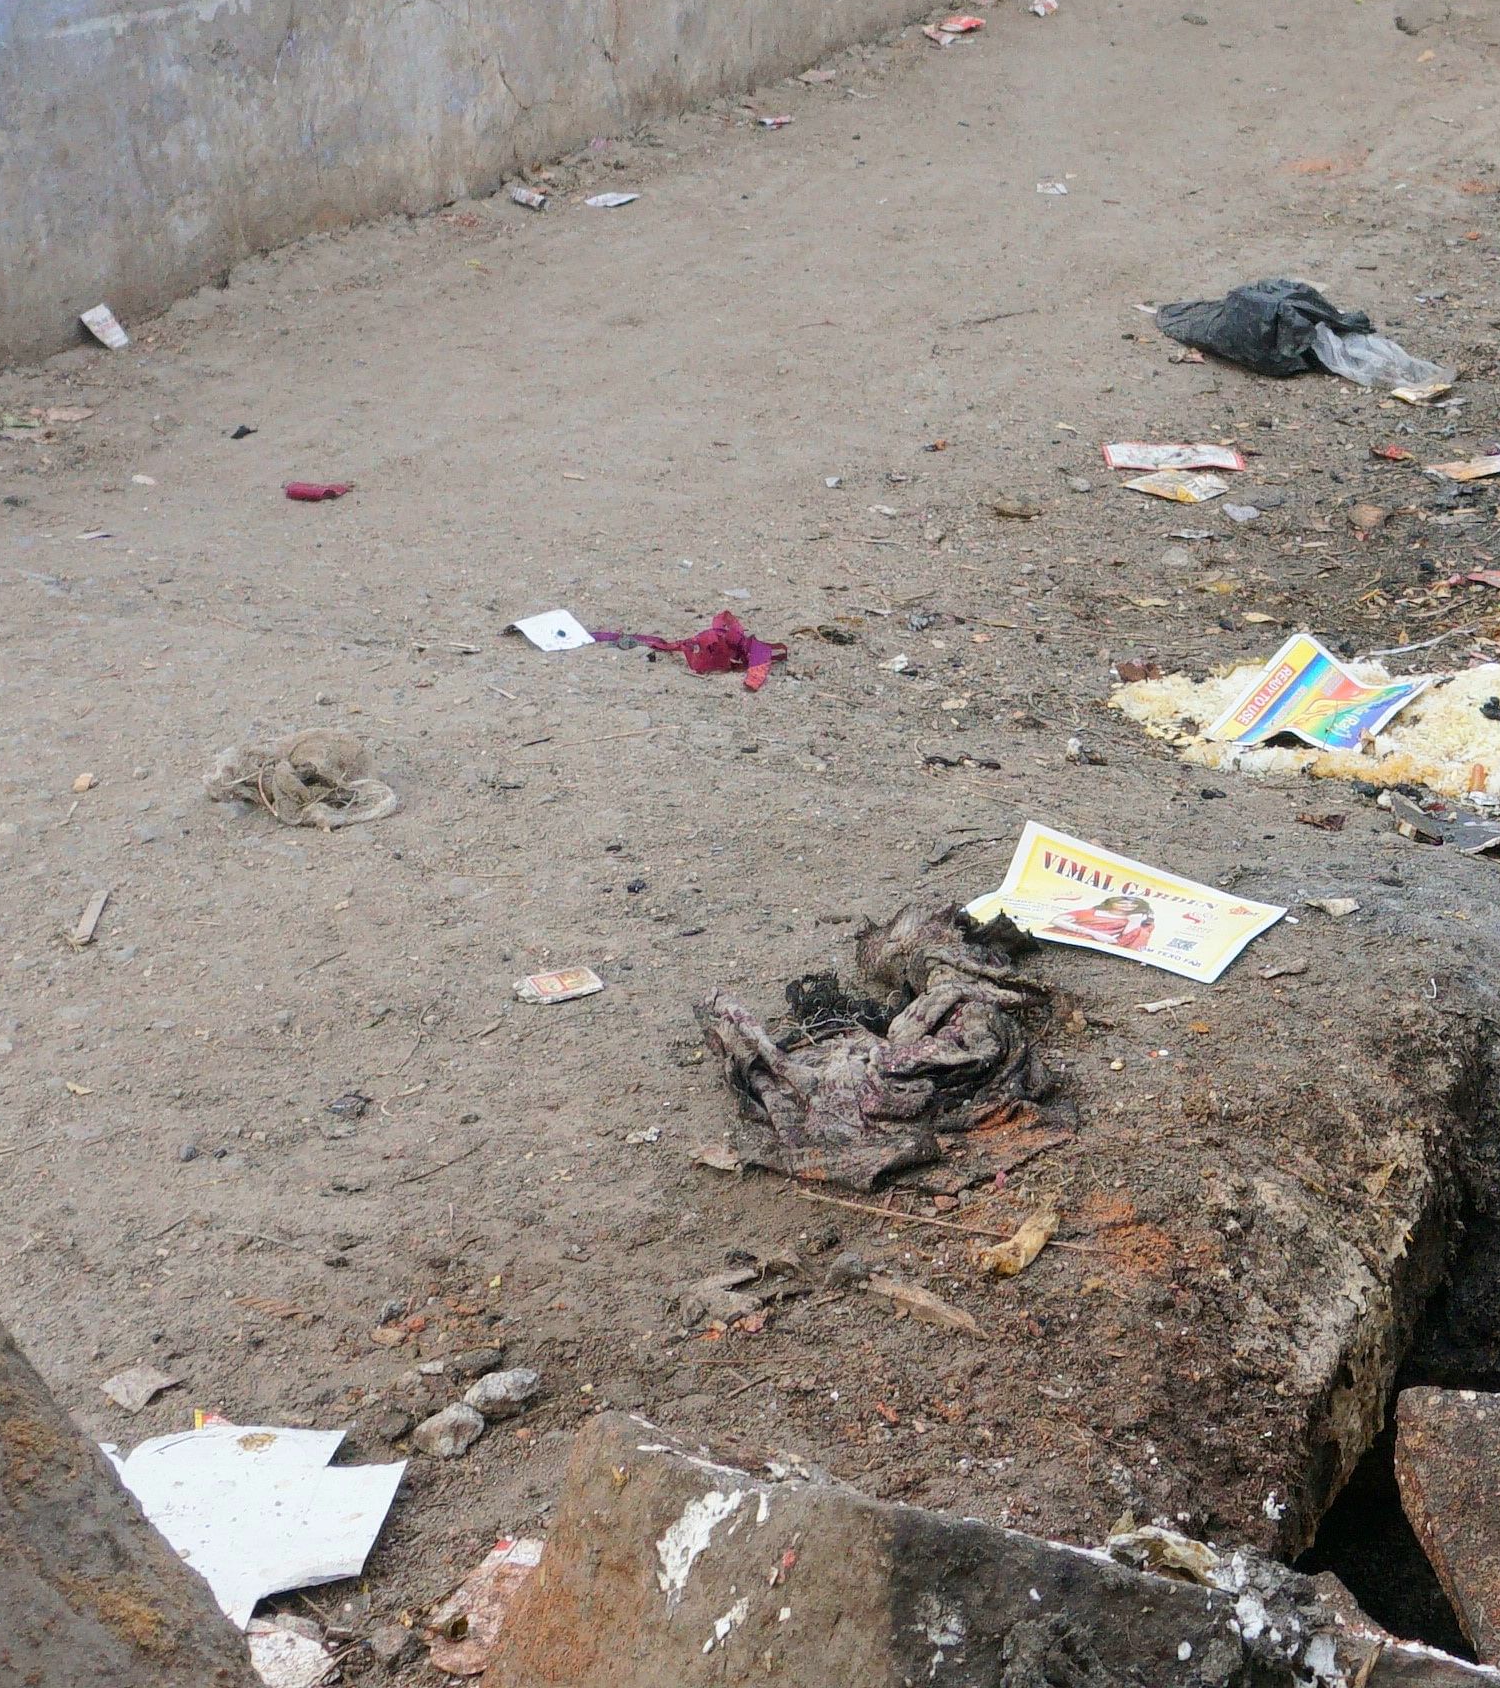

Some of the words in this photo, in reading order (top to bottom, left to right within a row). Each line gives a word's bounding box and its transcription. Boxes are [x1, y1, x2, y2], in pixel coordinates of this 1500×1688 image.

[1267, 665, 1293, 694] READY
[1254, 692, 1272, 709] TO
[1238, 703, 1258, 725] USE
[1044, 851, 1115, 893] VIMAL
[1121, 881, 1219, 910] GARDEN
